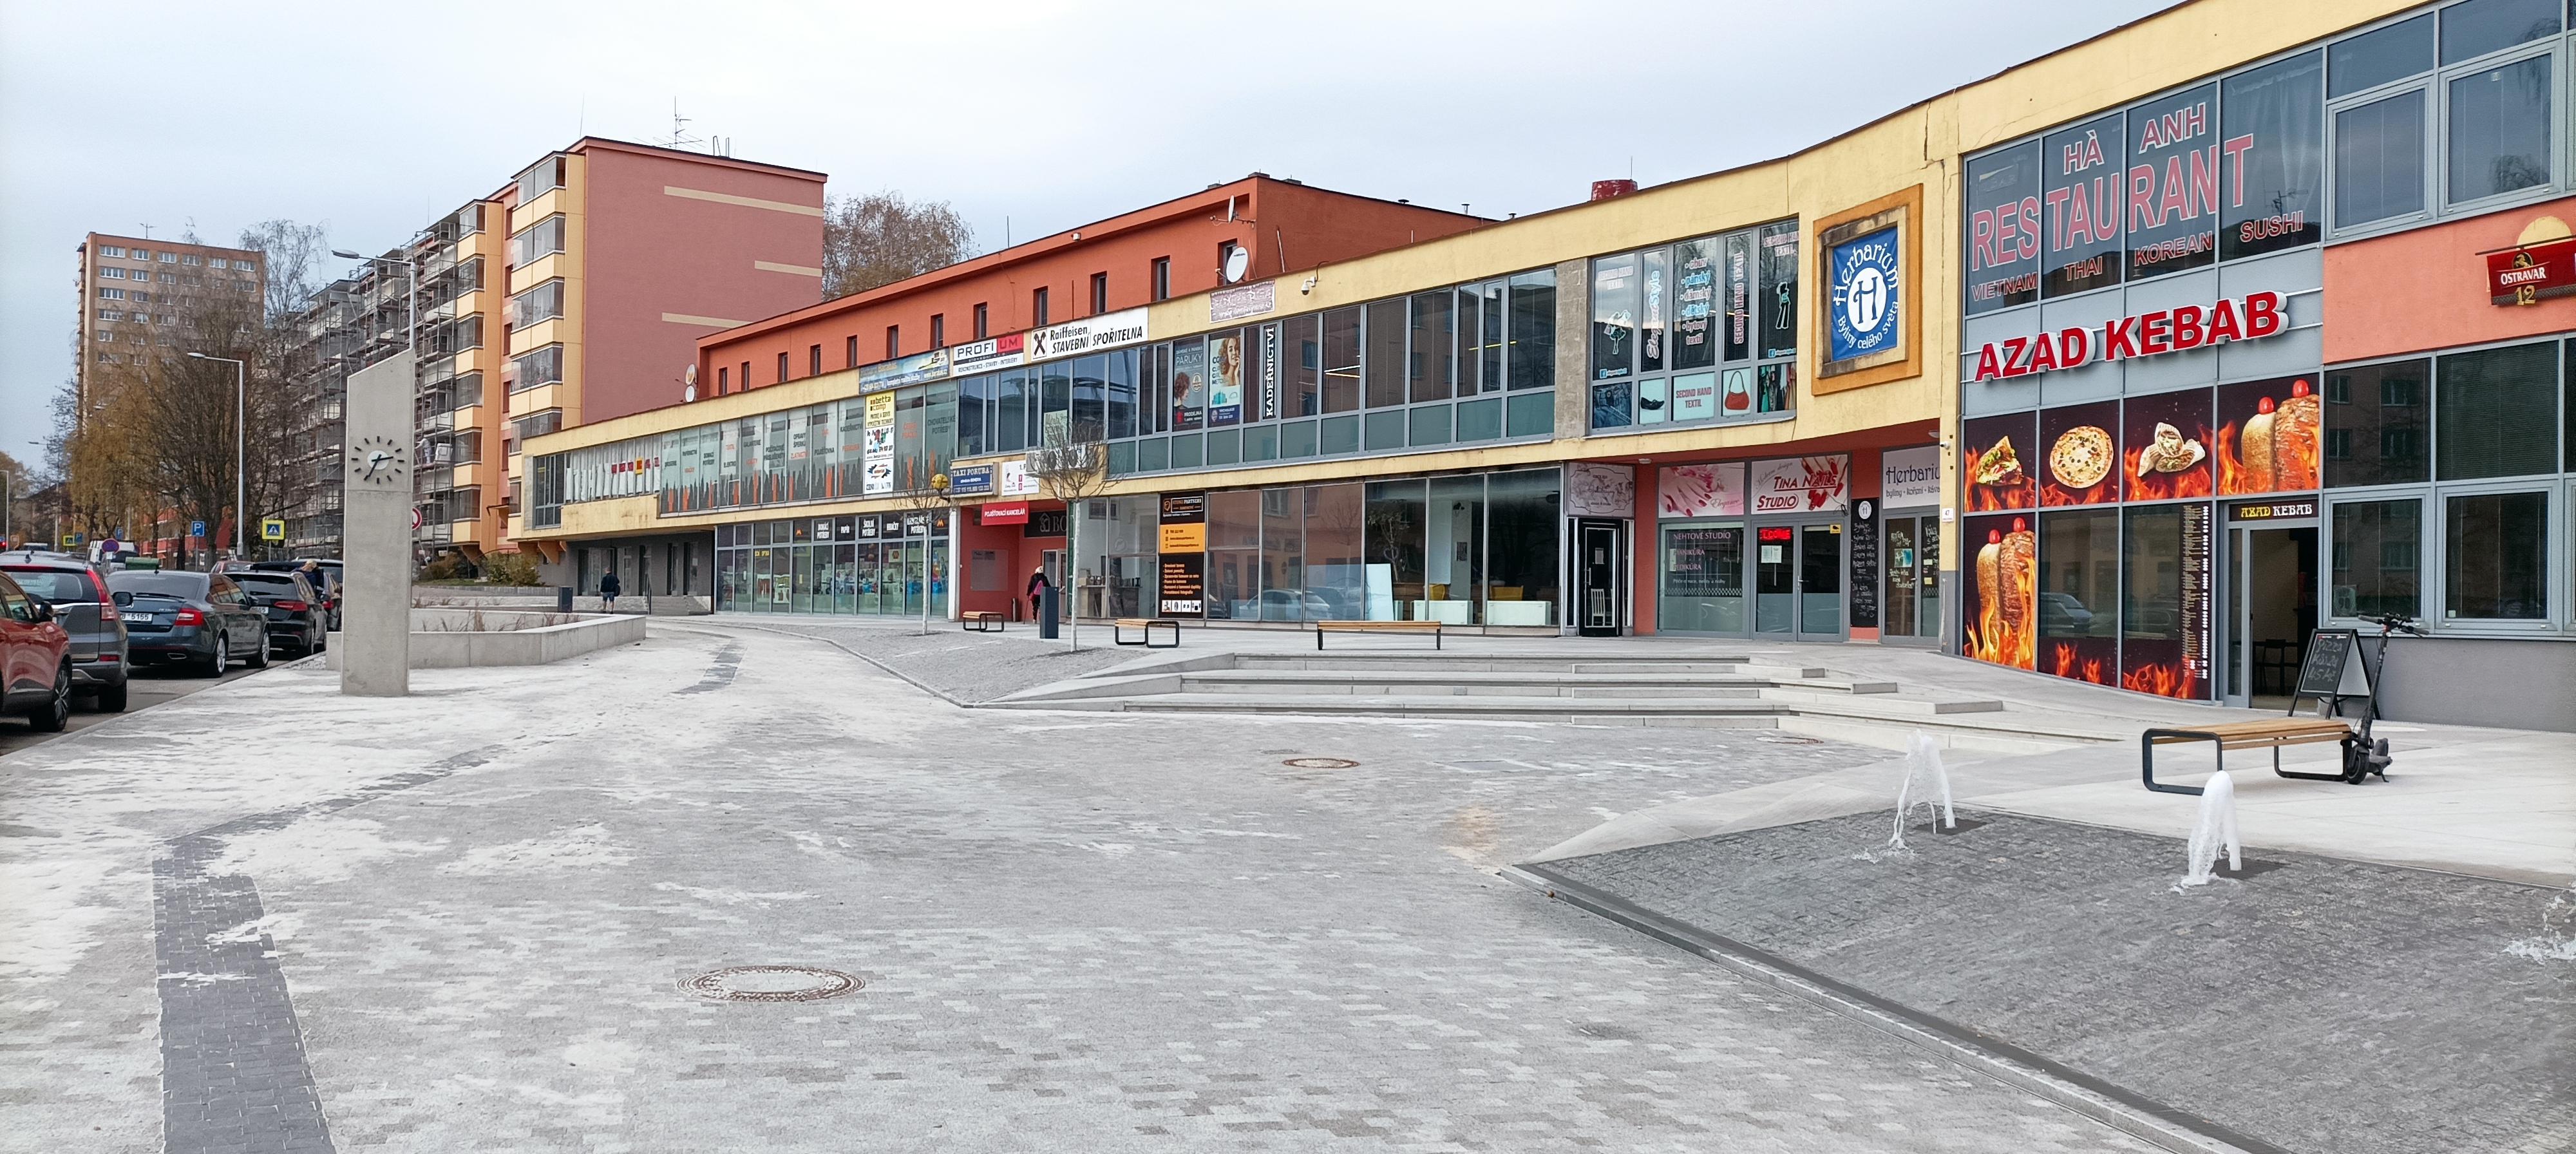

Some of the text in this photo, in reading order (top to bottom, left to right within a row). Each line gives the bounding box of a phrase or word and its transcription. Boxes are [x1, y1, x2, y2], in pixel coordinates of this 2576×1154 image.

[2063, 102, 2206, 175] HÀ ANH
[1972, 133, 2253, 271] RESTAURANT
[2240, 211, 2304, 243] SUSHI
[2134, 231, 2213, 267] KOREAN
[1689, 258, 1708, 270] obuv
[2063, 256, 2103, 281] THAI
[1685, 271, 1710, 288] pánský
[1833, 243, 1899, 307] Herbarium
[2501, 267, 2546, 285] OSTRAVAR
[1972, 271, 2038, 301] VIETNAM
[1683, 287, 1712, 302] dámský
[1734, 251, 1745, 345] SECOND HAND TEXTIL
[1853, 276, 1877, 324] H
[2515, 285, 2536, 305] 12
[1685, 302, 1710, 317] dětský
[1686, 320, 1708, 333] bytový
[1838, 301, 1898, 349] Byliny celého světa
[1050, 326, 1088, 341] Raiffeisen
[1052, 326, 1142, 354] STAVEBNÍ SPOŘITELNA
[1686, 333, 1703, 345] textil
[1974, 290, 2288, 383] AZAD KEBAB
[957, 337, 1018, 357] PROFI UM
[1176, 353, 1203, 366] PARUKY
[958, 363, 983, 373] REKONSTRUKCE
[1265, 325, 1275, 417] KADEŘNICTVÍ
[875, 395, 891, 404] betta
[1676, 386, 1712, 399] SECOND HAND
[1685, 400, 1702, 408] TEXTIL
[840, 422, 863, 432] KADEŘNICTVÍ
[927, 415, 956, 426] CHOVATELSKÉ
[952, 467, 990, 477] TAXI PORUBA
[1774, 475, 1837, 489] TINA NAILS
[1886, 489, 1902, 498] byliny
[1906, 486, 1923, 495] koření
[1757, 495, 1797, 507] STUDIO
[984, 507, 1026, 517] POJIŠŤOVACÍ KANCELÁŘ
[2240, 504, 2313, 518] AZAD KEBAB
[194, 523, 201, 532] P
[818, 522, 829, 531] DOMÁCÍ
[840, 524, 850, 534] PAPÍR
[863, 518, 875, 528] ŠKOLNÍ
[886, 522, 899, 531] HRAČKY
[862, 528, 876, 536] POTŘEBY
[1673, 531, 1703, 540] NEHTOVÉ
